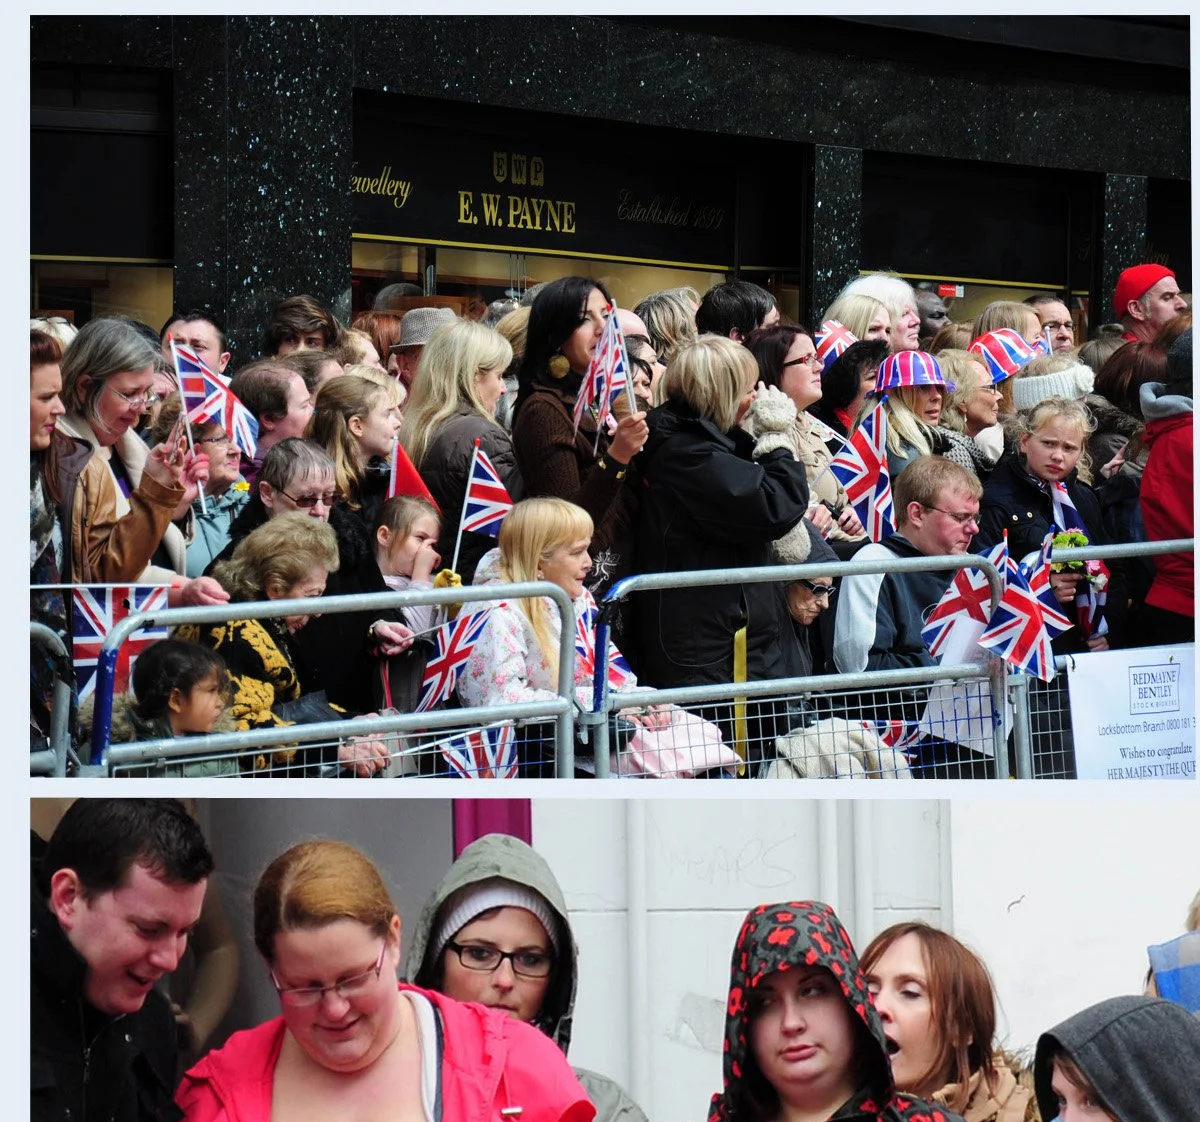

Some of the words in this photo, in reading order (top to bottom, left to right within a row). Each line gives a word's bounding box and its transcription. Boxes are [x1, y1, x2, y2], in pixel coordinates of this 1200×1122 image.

[351, 161, 413, 209] ewellery
[457, 190, 478, 224] E.
[481, 192, 503, 227] W.
[507, 195, 576, 234] PAYNE
[617, 188, 693, 227] Established
[1132, 670, 1177, 686] REDMAYNE
[1138, 685, 1173, 700] BENTLEY
[1098, 723, 1142, 736] Locksbottom
[1143, 720, 1166, 733] Branch
[1166, 719, 1181, 731] 0800
[1119, 746, 1146, 760] Wishes
[1147, 747, 1156, 758] to
[1157, 741, 1193, 760] congratulate
[1107, 767, 1124, 780] HER
[1125, 763, 1166, 779] MAJESTY
[1166, 761, 1181, 776] THE
